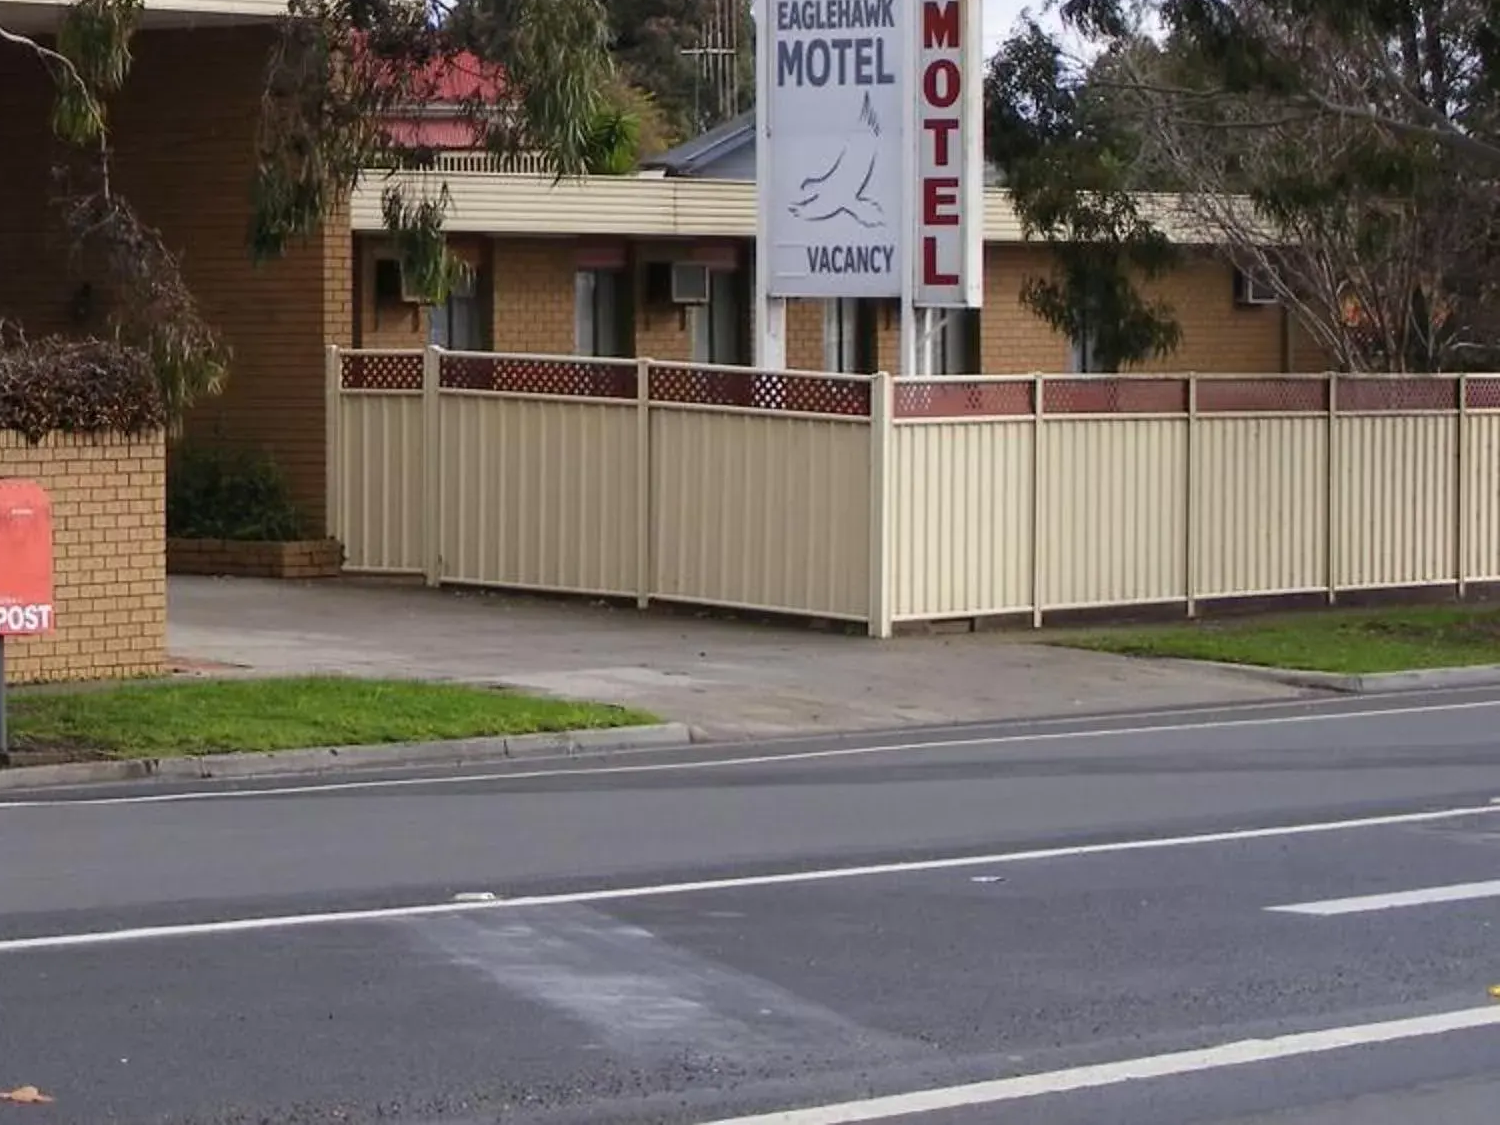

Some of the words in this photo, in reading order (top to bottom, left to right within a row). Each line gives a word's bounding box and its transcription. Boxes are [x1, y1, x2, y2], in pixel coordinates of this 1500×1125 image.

[777, 37, 895, 87] MOTEL
[923, 1, 961, 286] MOTEL
[807, 245, 895, 275] VACANCY
